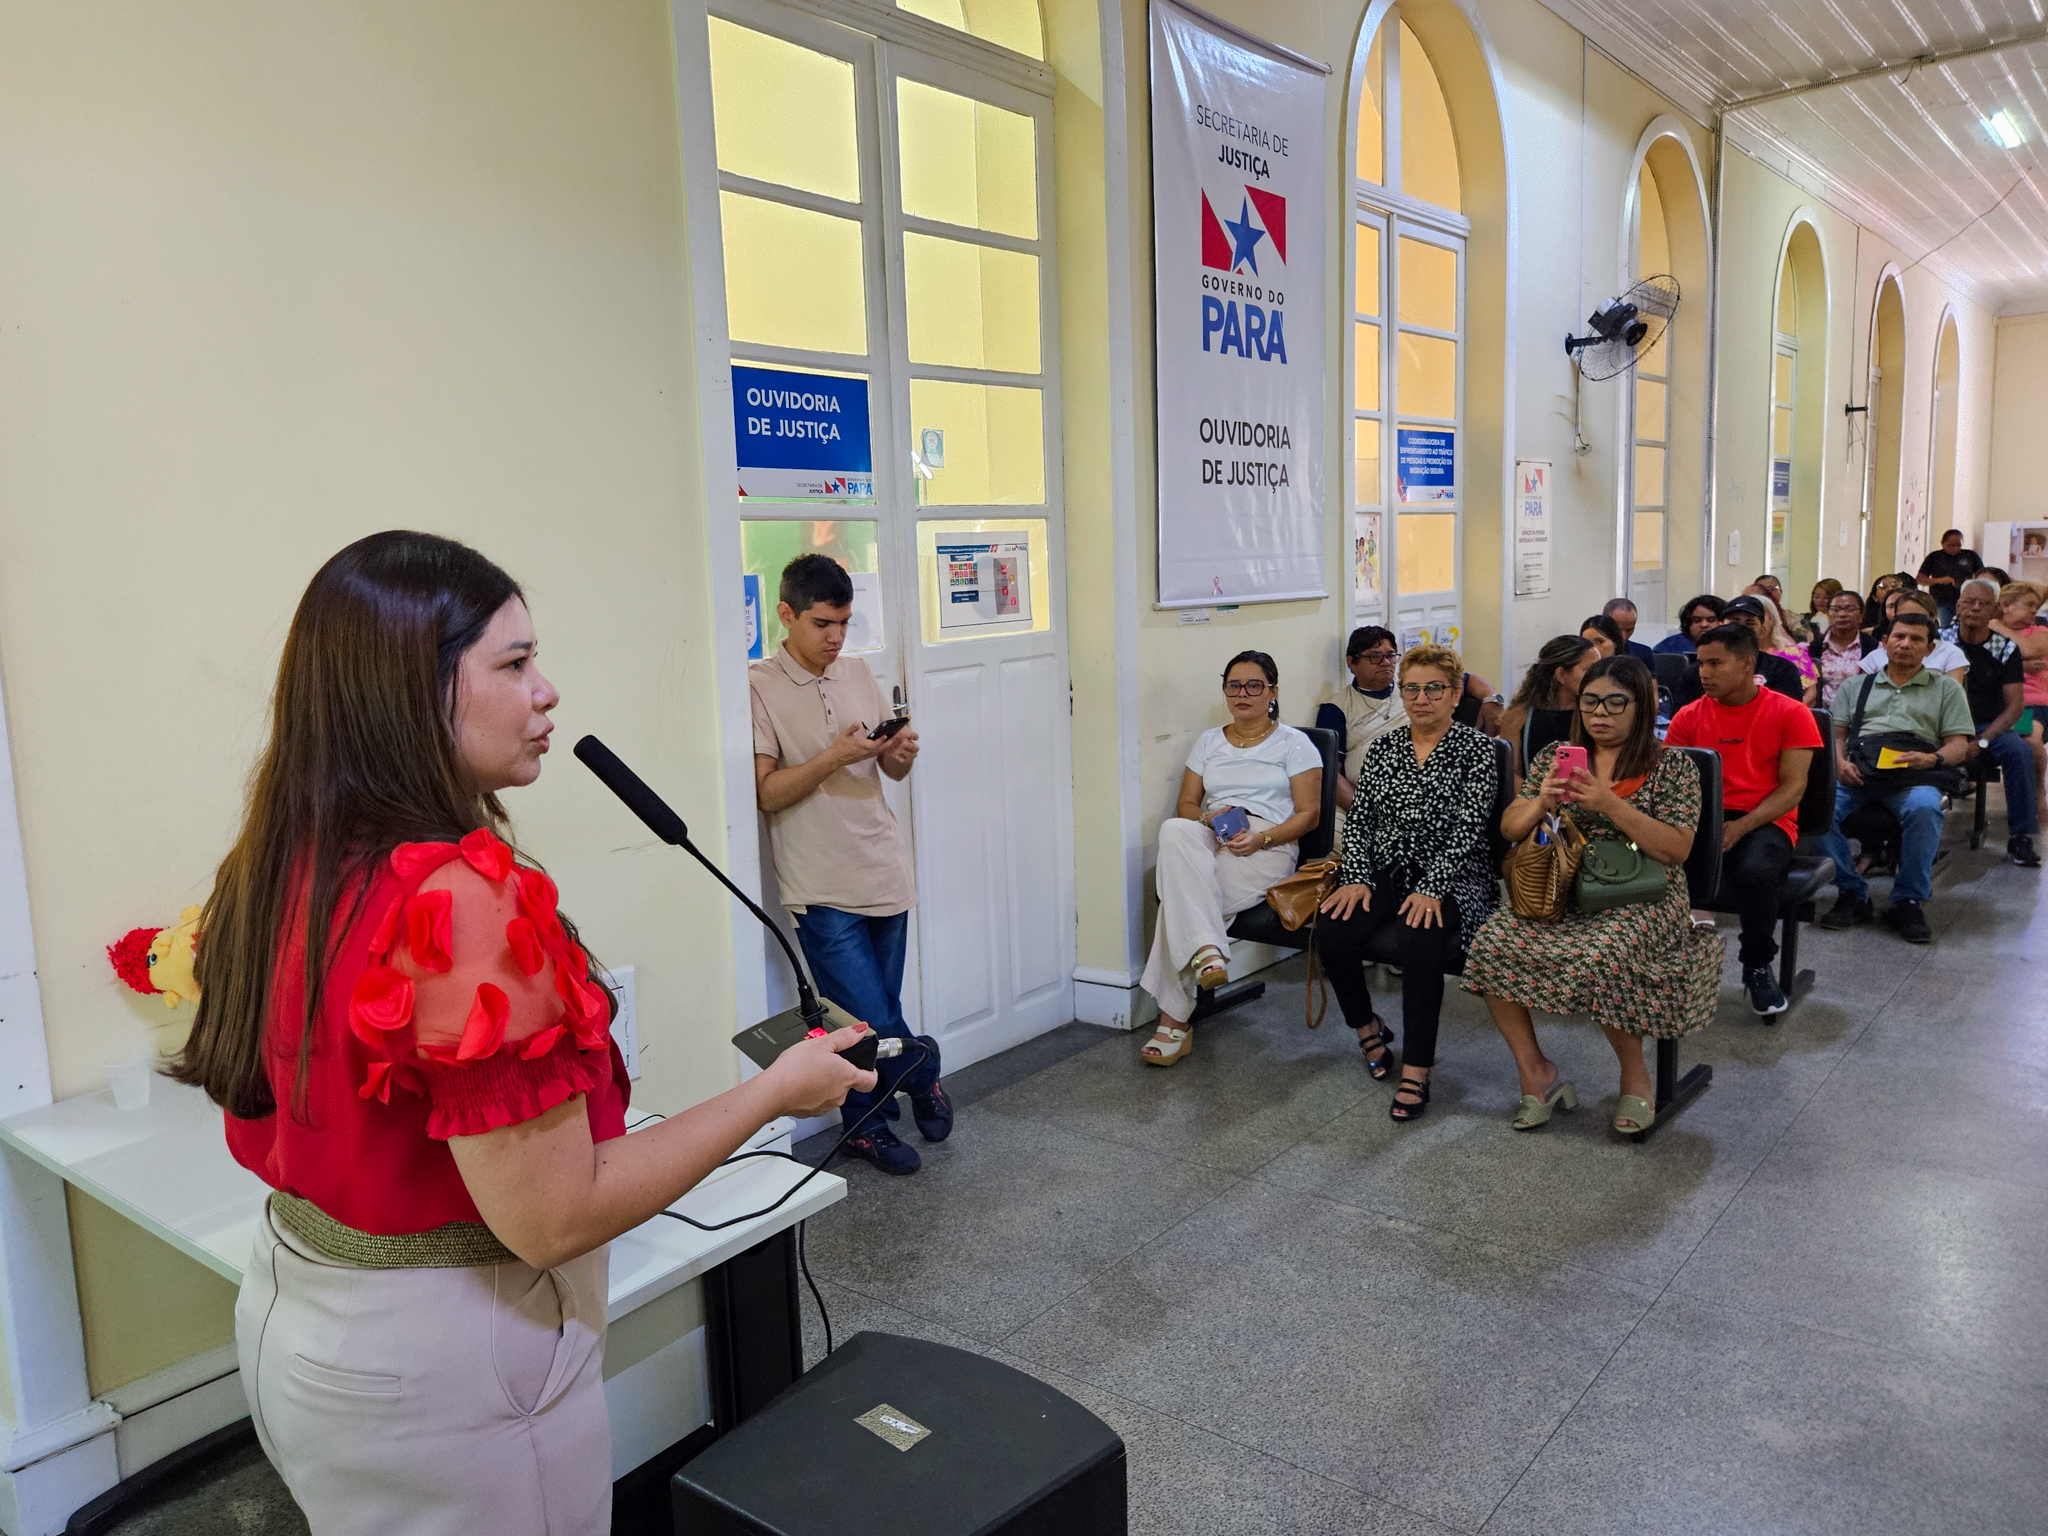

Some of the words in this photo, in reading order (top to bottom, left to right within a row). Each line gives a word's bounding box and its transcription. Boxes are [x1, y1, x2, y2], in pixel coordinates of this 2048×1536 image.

[1196, 104, 1270, 151] SECRETARIA
[1273, 134, 1289, 157] DE
[1218, 144, 1270, 180] JUSTIÇA
[1201, 274, 1262, 301] GOVERNO
[1268, 289, 1285, 305] DO
[746, 387, 841, 413] OUVIDORIA
[747, 416, 772, 436] DE
[775, 419, 841, 445] JUSTIÇA
[1199, 417, 1291, 450] OUVIDORIA
[1202, 458, 1223, 485] DE
[1227, 460, 1290, 494] JUSTIÇA
